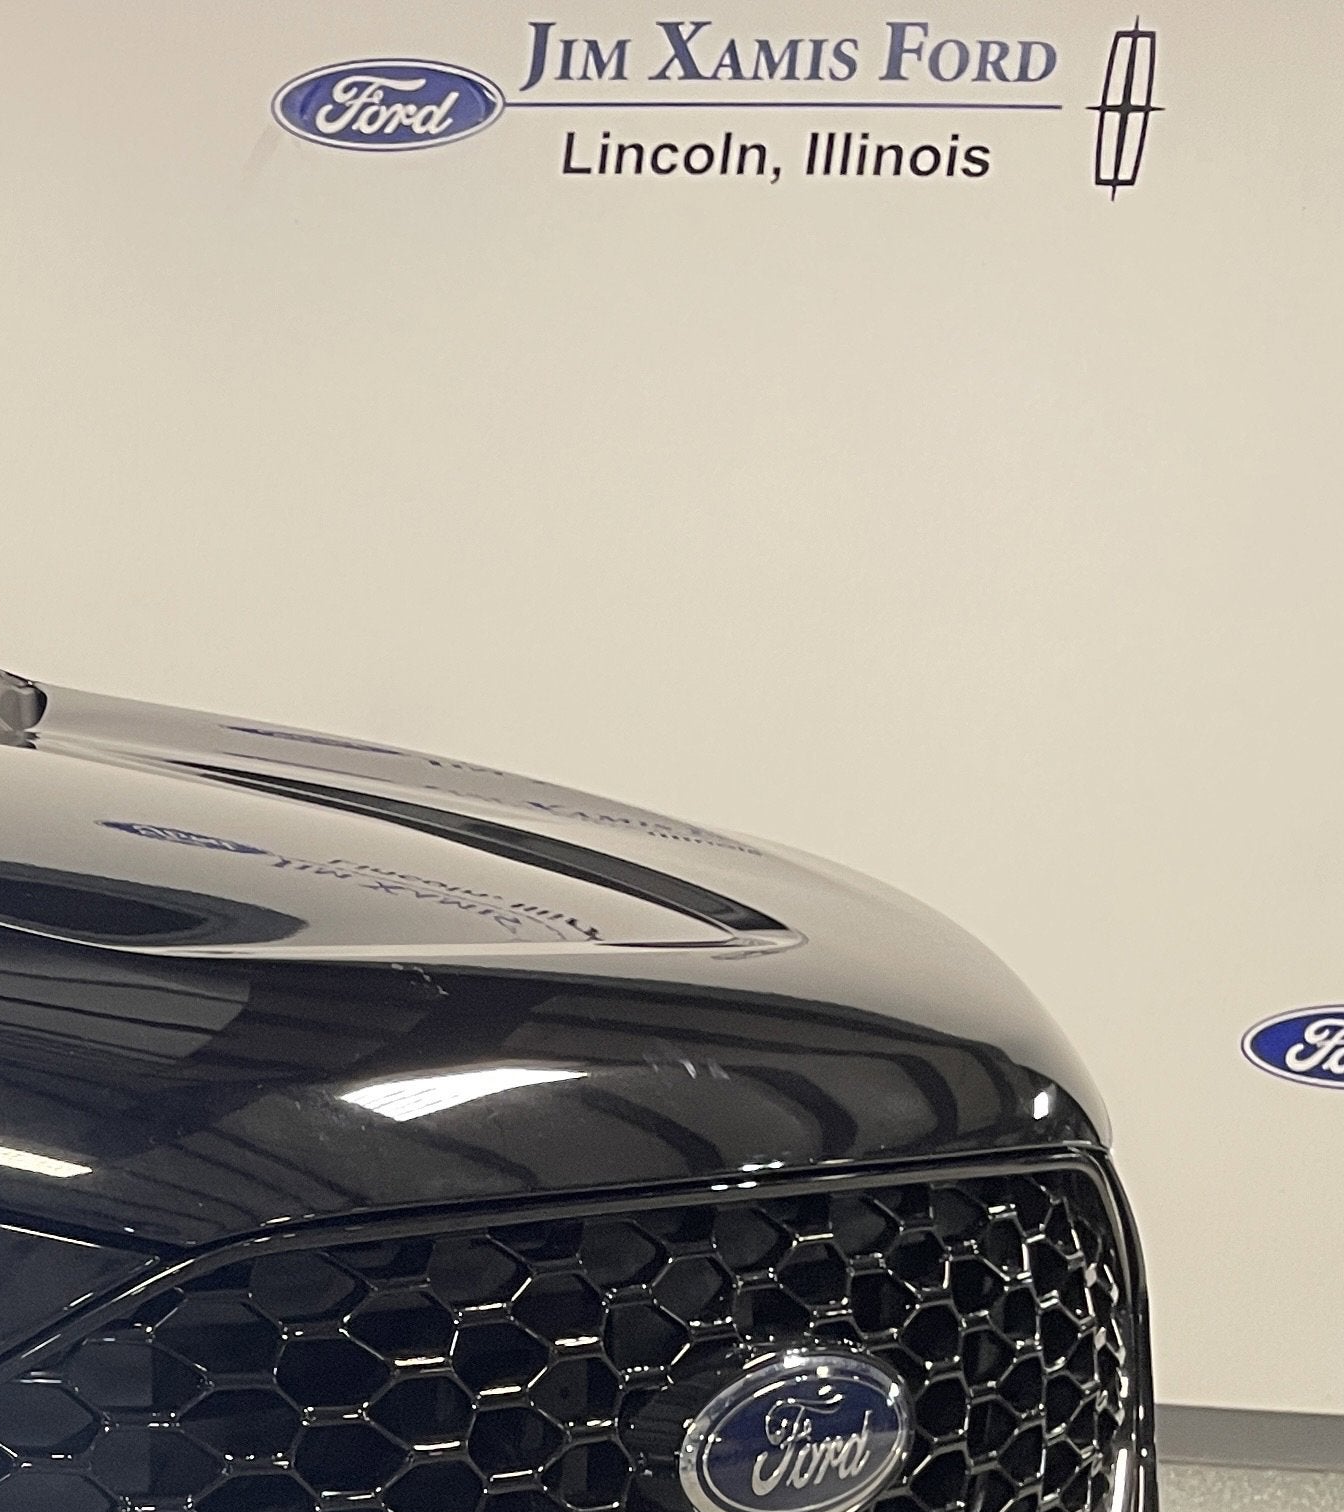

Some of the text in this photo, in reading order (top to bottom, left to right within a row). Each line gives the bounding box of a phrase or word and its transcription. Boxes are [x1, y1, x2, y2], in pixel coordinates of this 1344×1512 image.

[519, 21, 1057, 92] JIM XAMIS FORD
[315, 75, 459, 135] Ford
[562, 131, 991, 185] Lincoln, Illinois
[752, 1393, 872, 1496] Ford
